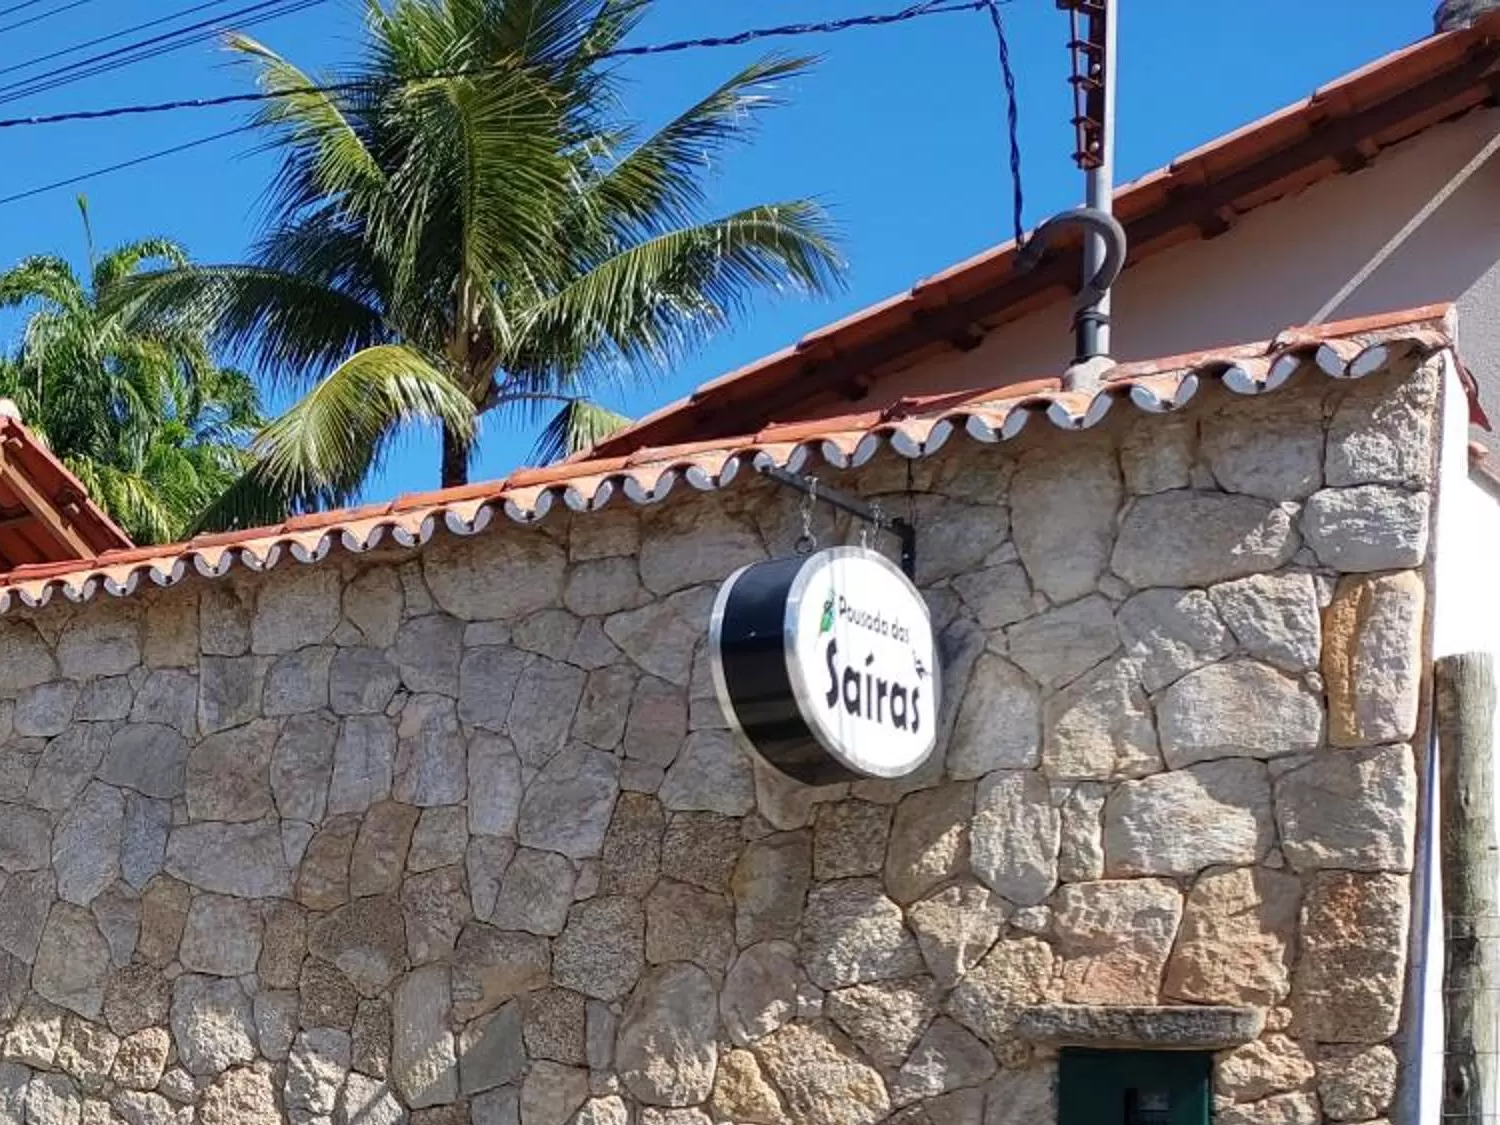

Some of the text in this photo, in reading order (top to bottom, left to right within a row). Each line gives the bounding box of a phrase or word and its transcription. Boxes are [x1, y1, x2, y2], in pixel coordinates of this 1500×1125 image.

[838, 595, 910, 644] Pousada das
[826, 637, 920, 734] Saíras
